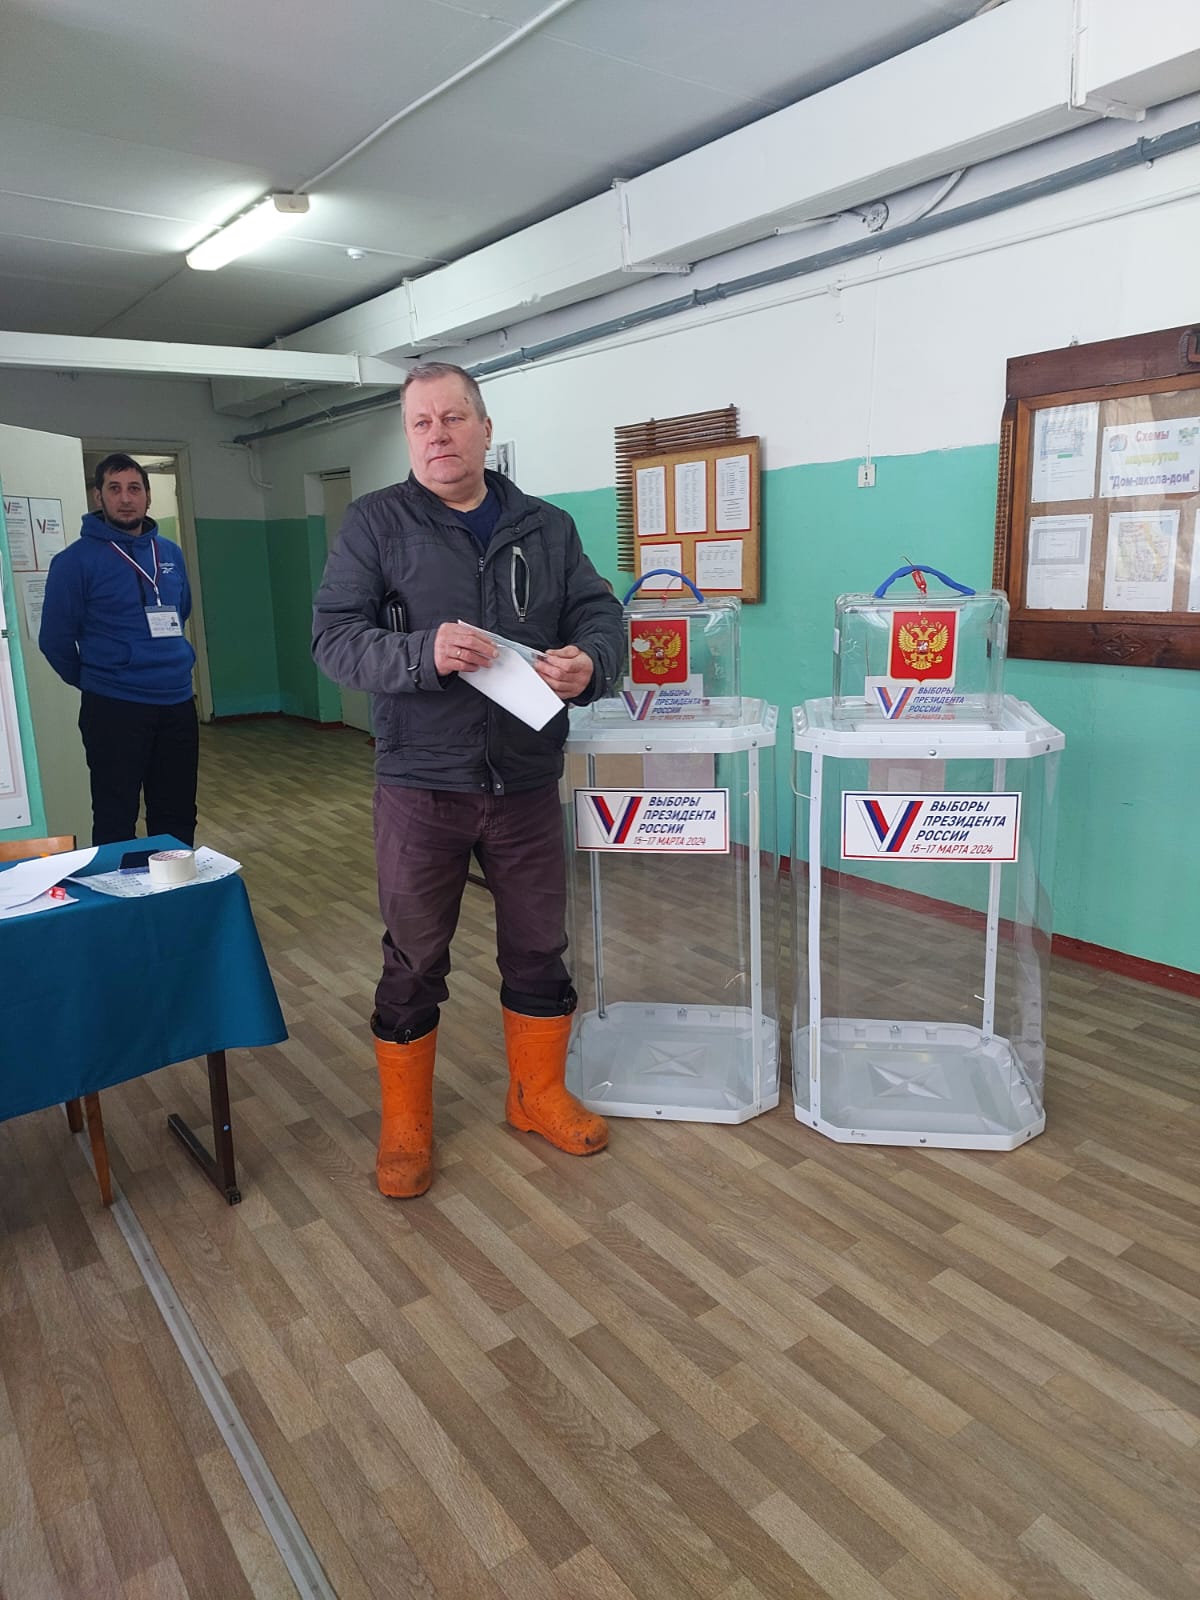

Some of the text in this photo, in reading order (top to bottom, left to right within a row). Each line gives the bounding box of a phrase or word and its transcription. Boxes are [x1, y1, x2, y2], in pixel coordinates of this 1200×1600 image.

[1136, 430, 1170, 443] Схемы
[918, 687, 955, 695] ВЫБОРЫ
[913, 696, 965, 704] ПРЕЗИДЕНТА
[908, 705, 942, 713] РОССИИ
[648, 796, 701, 807] ВЫБОРЫ
[930, 801, 990, 812] ВЫБОРЫ
[643, 810, 716, 822] ПРЕЗИДЕНТА
[923, 816, 1007, 828] ПРЕЗИДЕНТА
[637, 824, 685, 834] РОССИИ
[916, 830, 970, 841] РОССИИ
[658, 837, 684, 845] МАРТА
[685, 837, 706, 846] 2024
[938, 845, 969, 854] МАРТА
[970, 845, 994, 855] 2024
